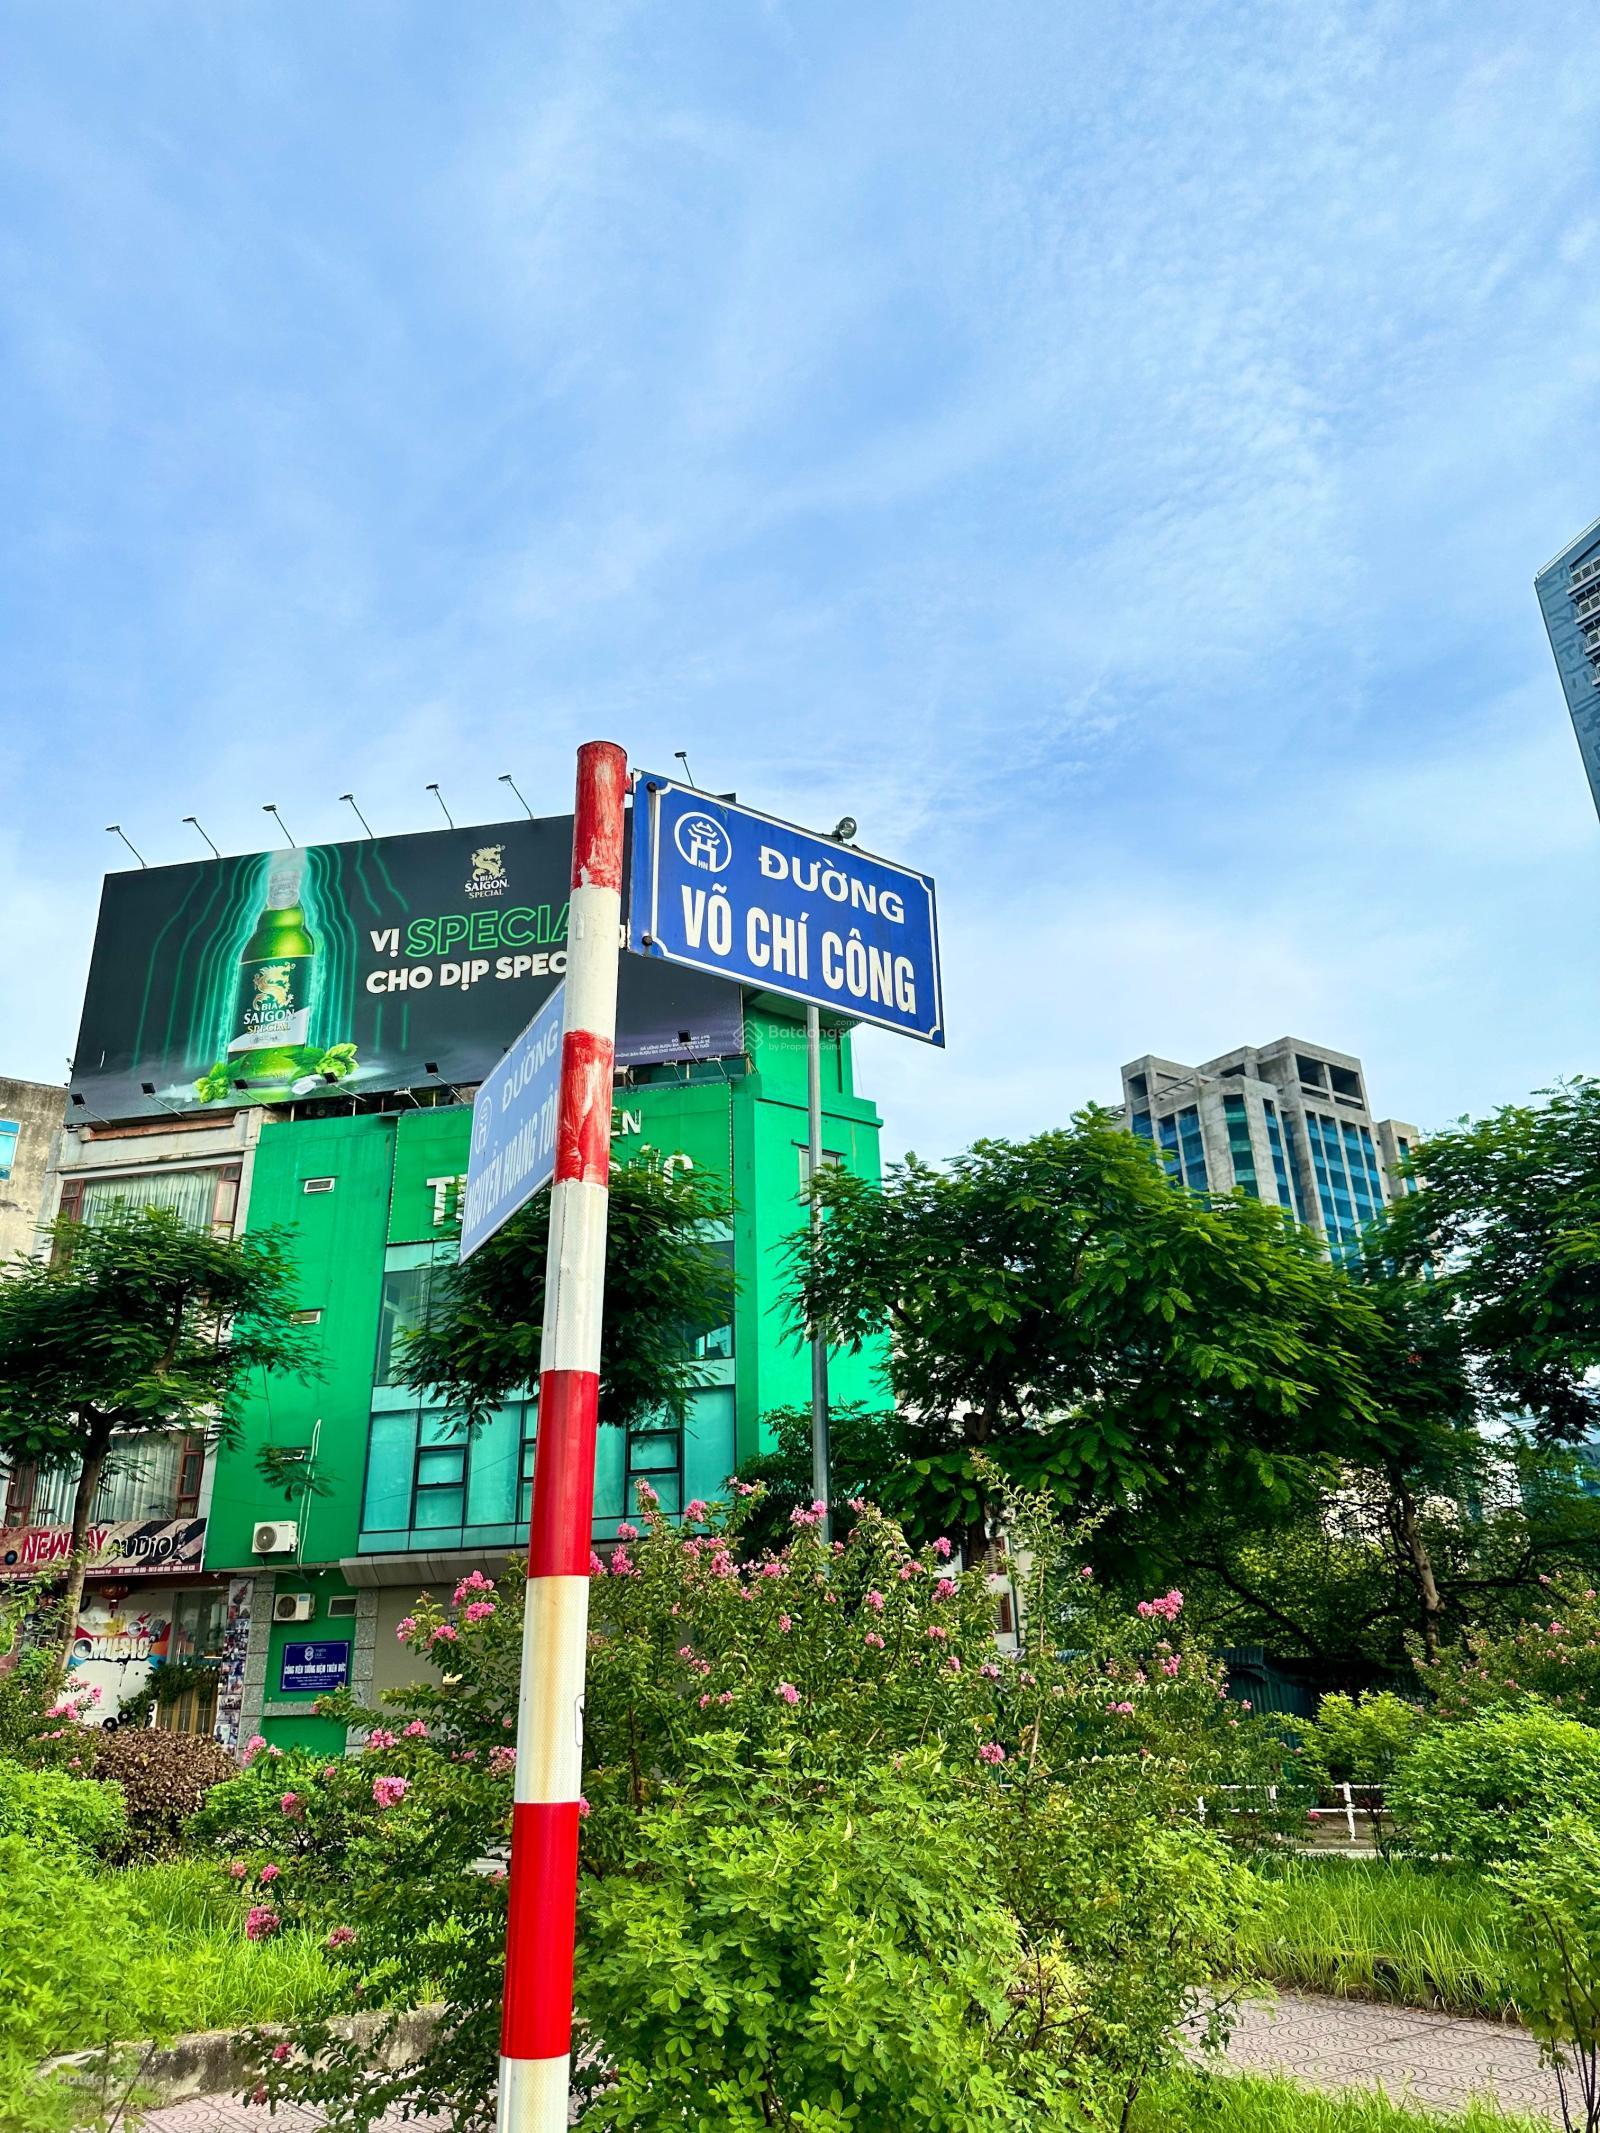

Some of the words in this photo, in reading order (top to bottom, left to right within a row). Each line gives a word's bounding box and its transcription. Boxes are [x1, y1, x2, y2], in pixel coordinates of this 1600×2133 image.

[464, 879, 508, 893] SAIGON
[468, 888, 504, 899] SPECIAL
[758, 845, 905, 924] ĐƯỜNG
[370, 928, 400, 958] VỊ
[681, 883, 732, 956] VÕ
[746, 906, 810, 981] CHÍ
[821, 928, 917, 1014] CÔNG
[366, 966, 433, 993] CHO
[440, 958, 490, 991] DỊP
[495, 950, 568, 980] SPEC
[243, 1008, 296, 1025] SAIGON
[502, 1020, 558, 1113] ĐƯỜNG
[92, 1637, 150, 1660] MUSIC
